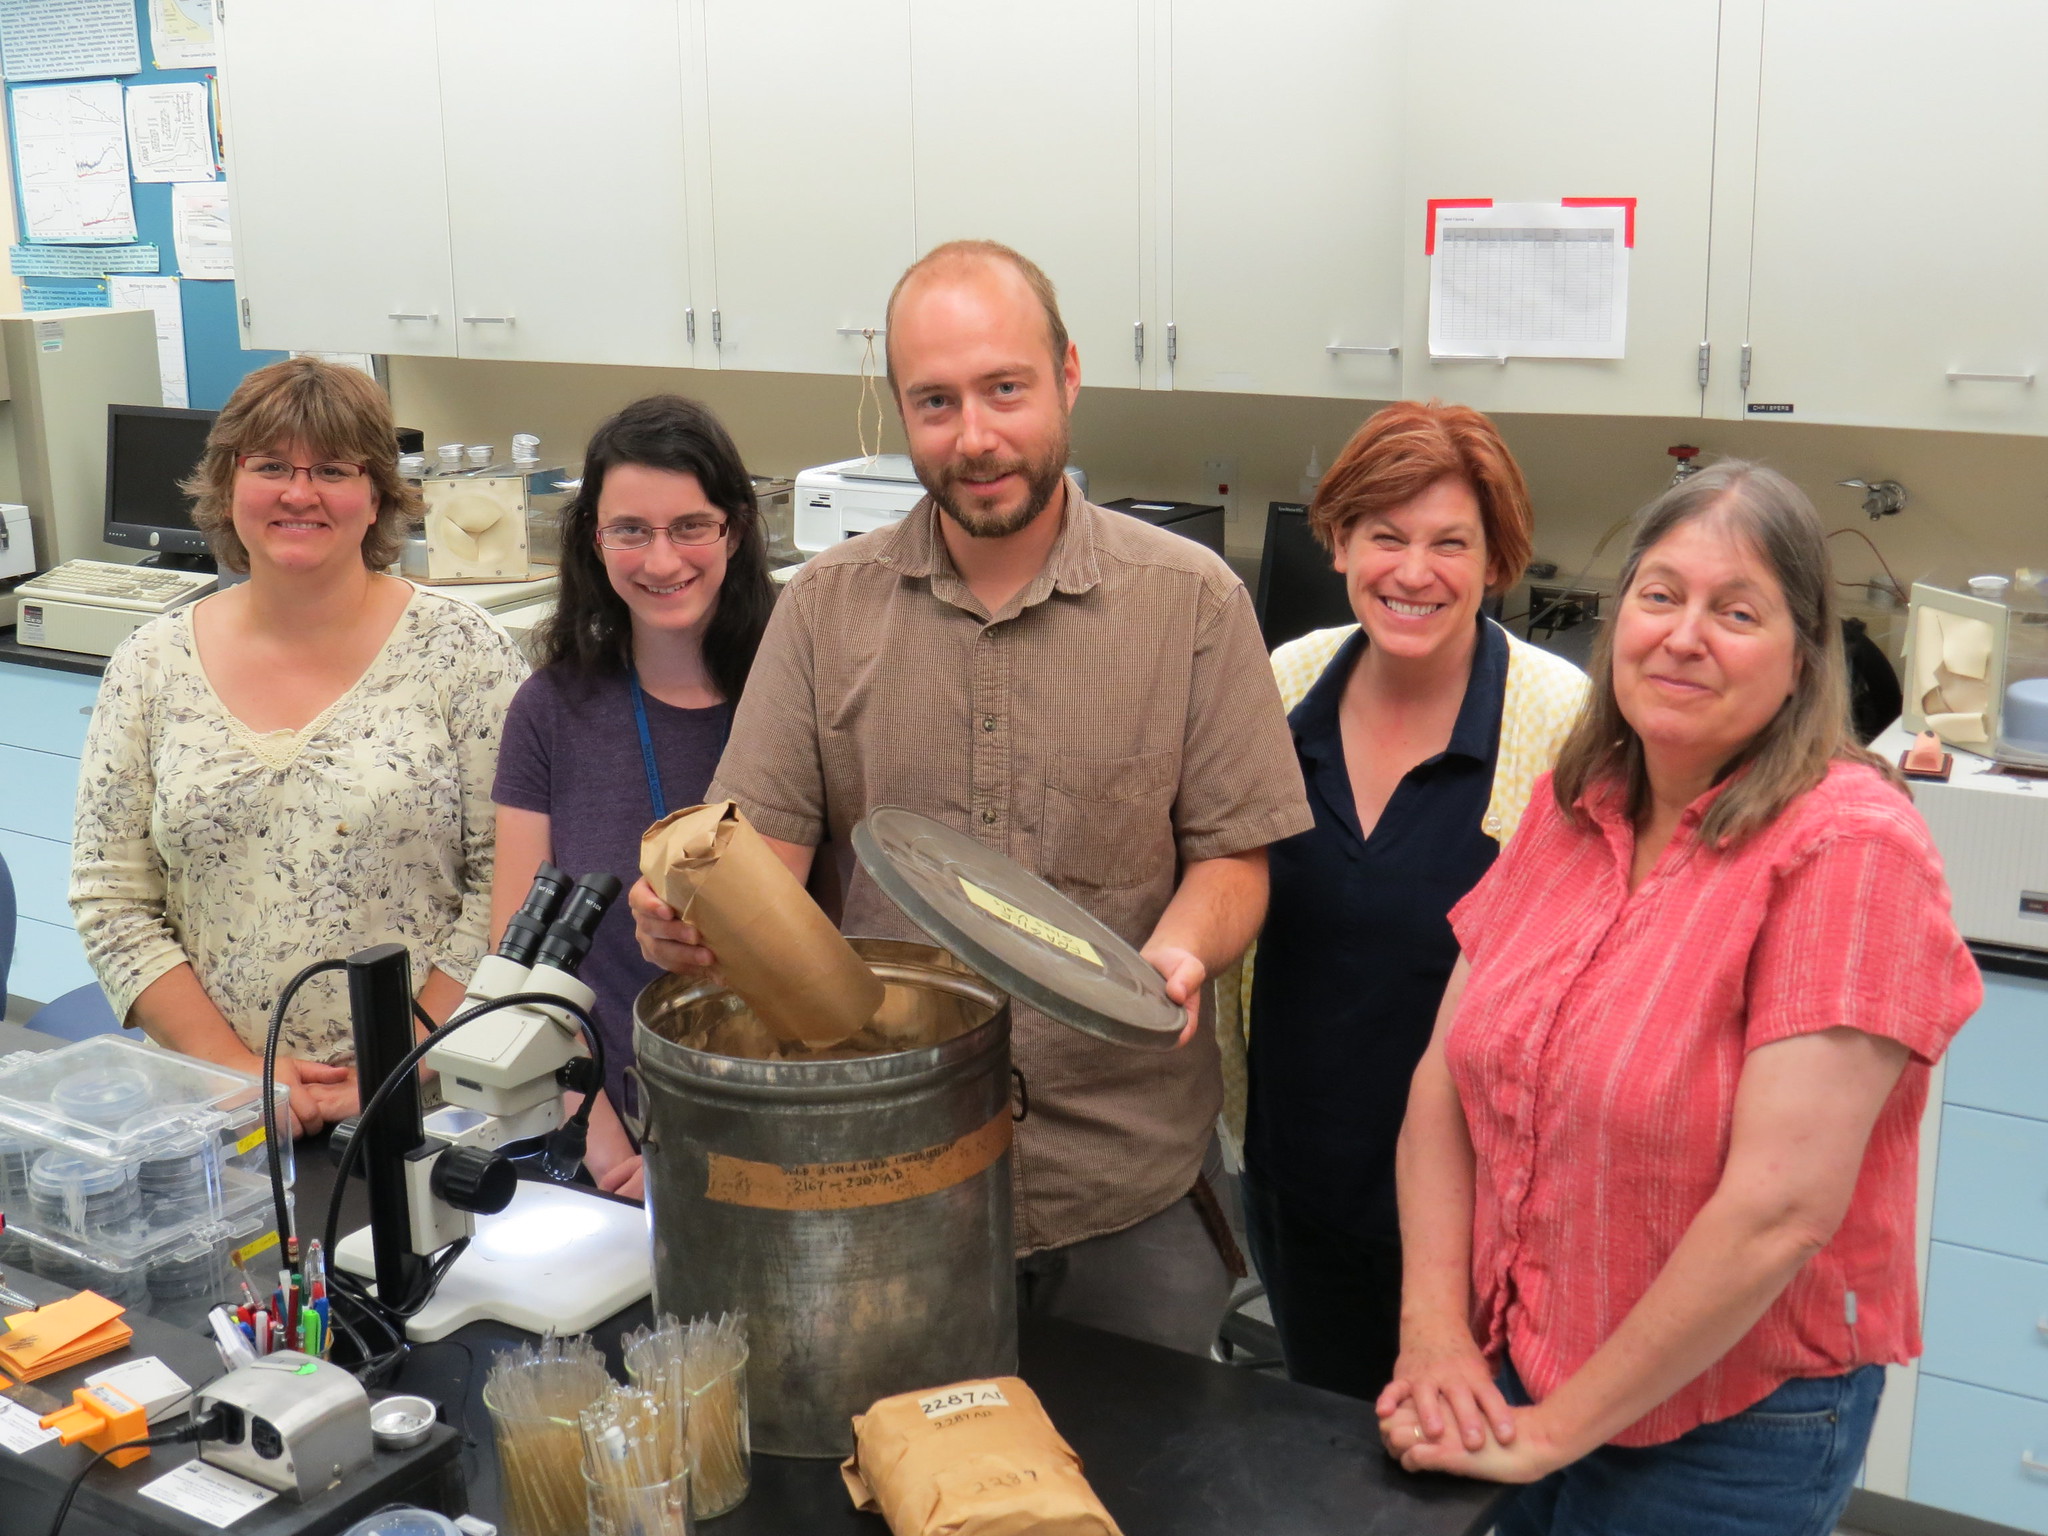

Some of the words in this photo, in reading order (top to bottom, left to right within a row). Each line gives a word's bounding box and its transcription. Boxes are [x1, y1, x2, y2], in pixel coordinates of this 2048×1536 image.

[921, 1391, 975, 1414] 2287
[934, 1413, 970, 1431] 2287
[975, 1469, 1038, 1494] 2287
